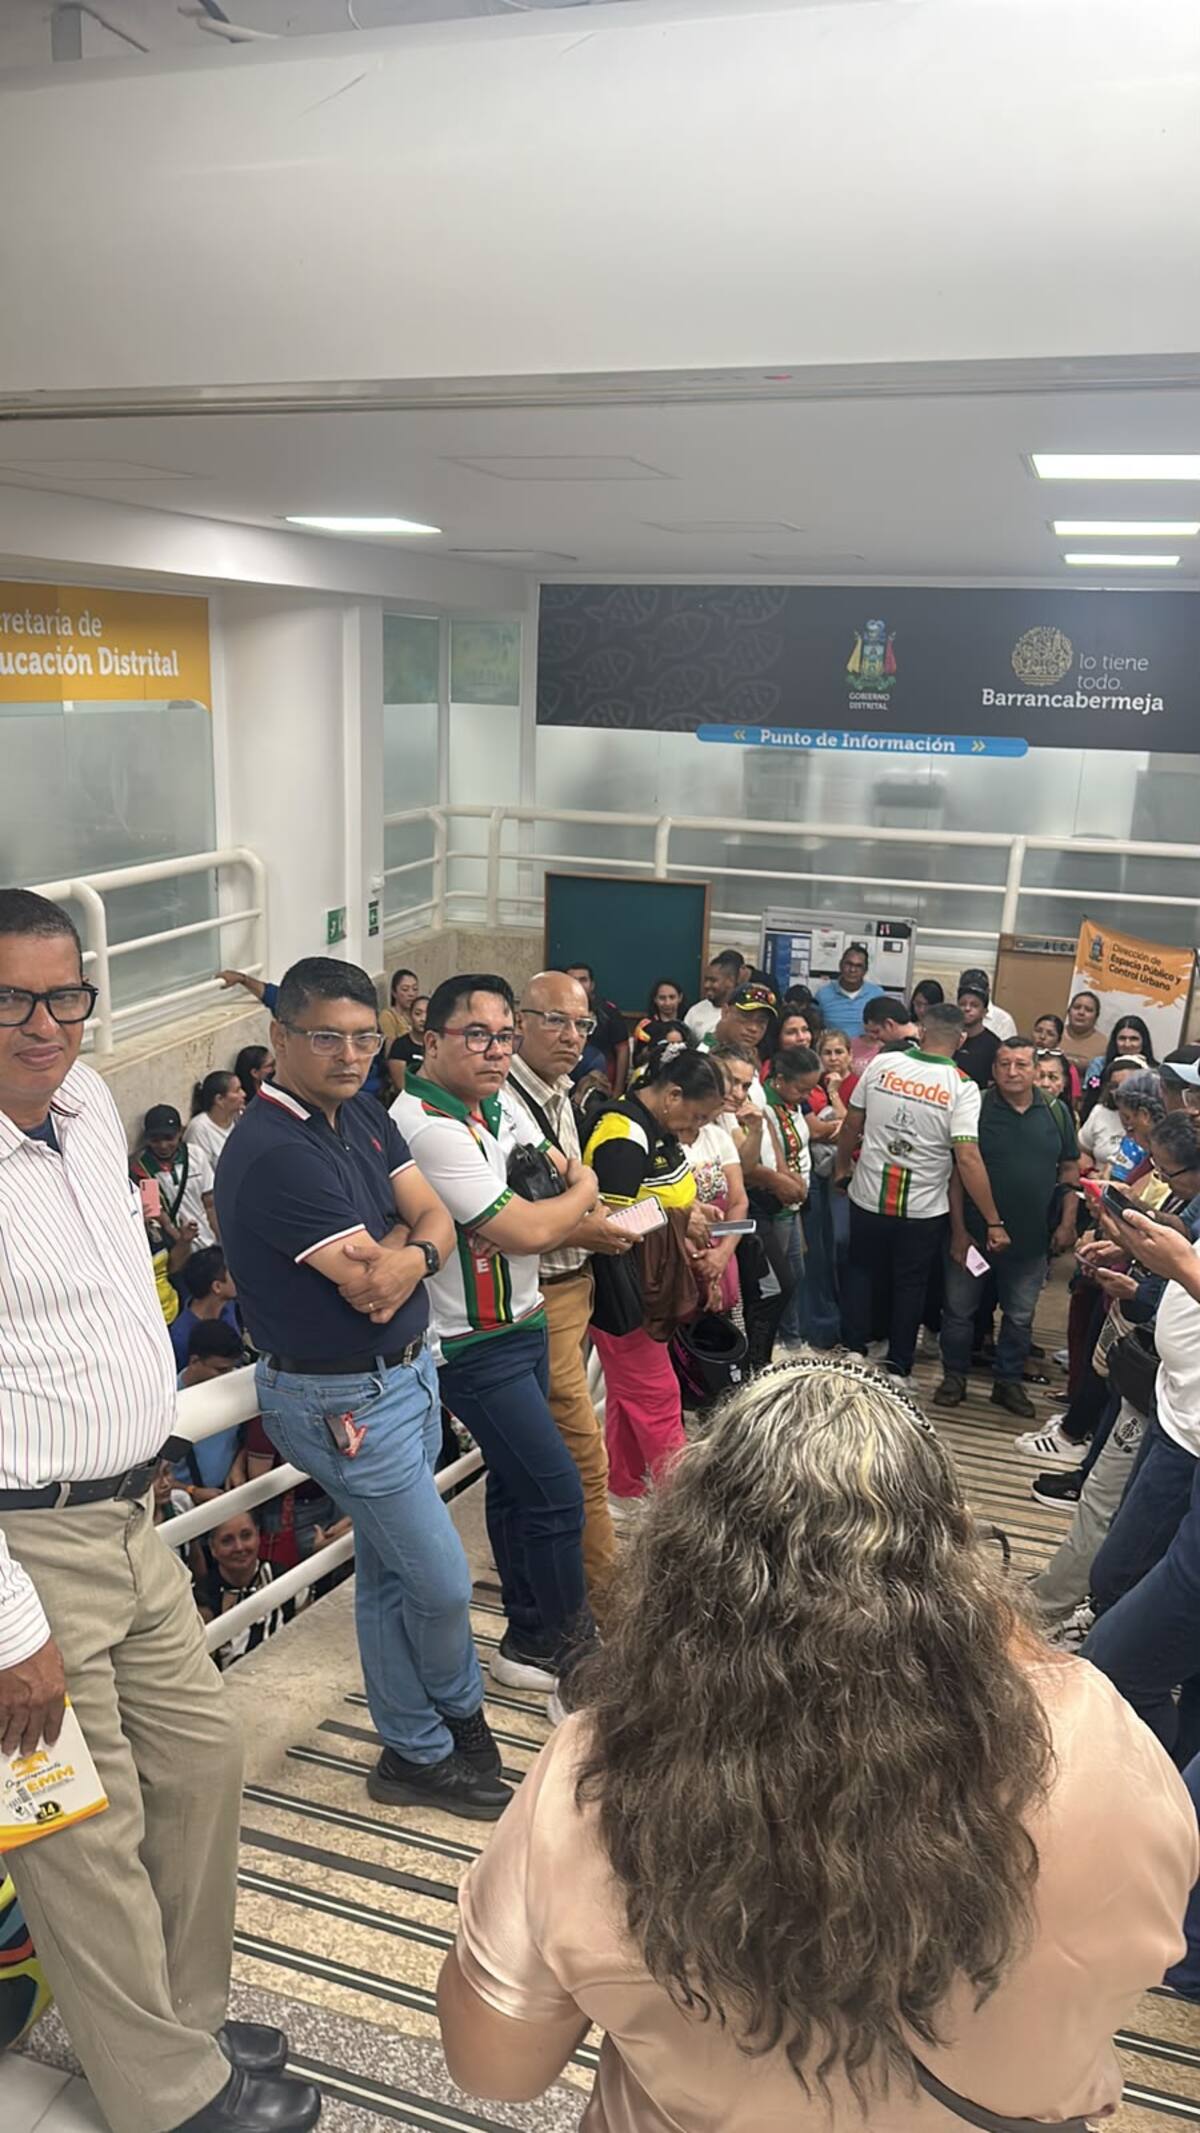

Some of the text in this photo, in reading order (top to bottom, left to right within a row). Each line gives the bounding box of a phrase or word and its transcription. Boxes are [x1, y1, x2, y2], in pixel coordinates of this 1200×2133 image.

[0, 608, 102, 637] retaría de
[98, 646, 179, 677] Distrital
[1080, 653, 1149, 671] lo tiene
[982, 688, 1164, 715] Barrancabermeja
[760, 729, 956, 753] Punto de Información
[1108, 964, 1139, 981] Control
[1139, 974, 1171, 992] Urbano
